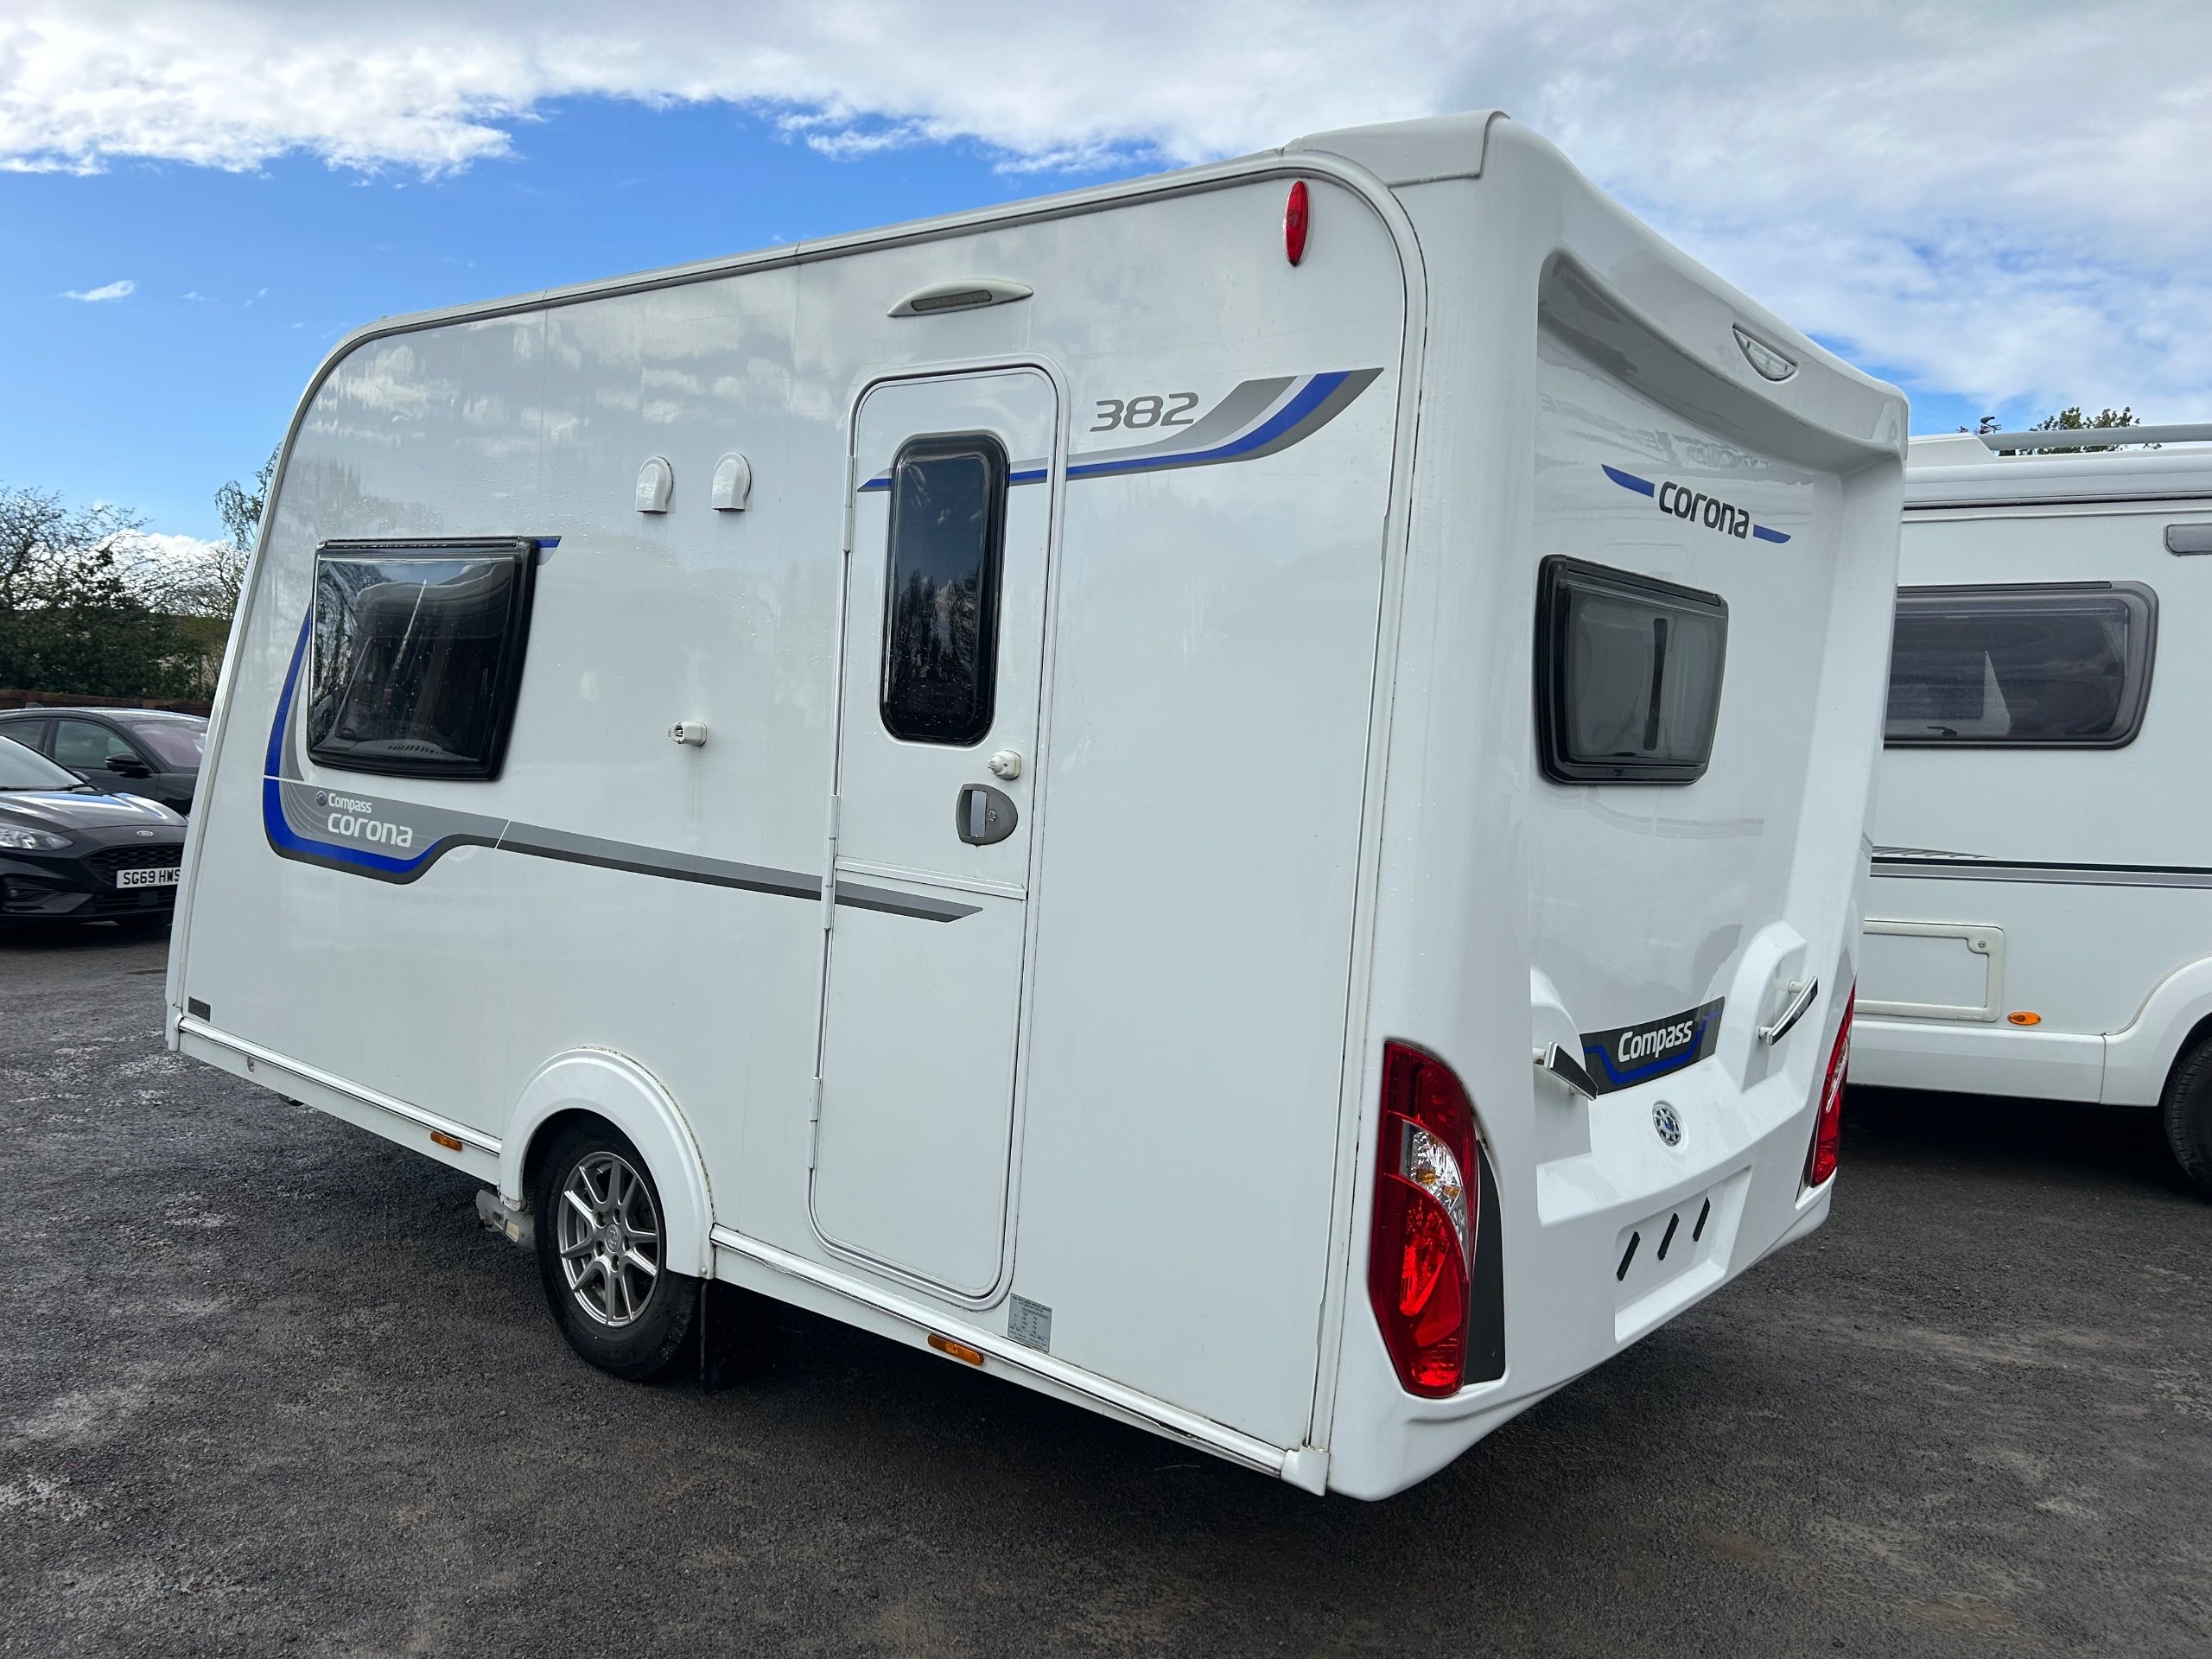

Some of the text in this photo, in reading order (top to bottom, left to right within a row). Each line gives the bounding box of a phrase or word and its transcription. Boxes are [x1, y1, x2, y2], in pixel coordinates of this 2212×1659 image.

[1090, 392, 1199, 432] 382
[1659, 481, 1750, 539] corona
[328, 792, 372, 813] Compass
[327, 812, 413, 848] corona
[124, 869, 181, 885] SG69 HWS
[1618, 1020, 1694, 1062] Compass
